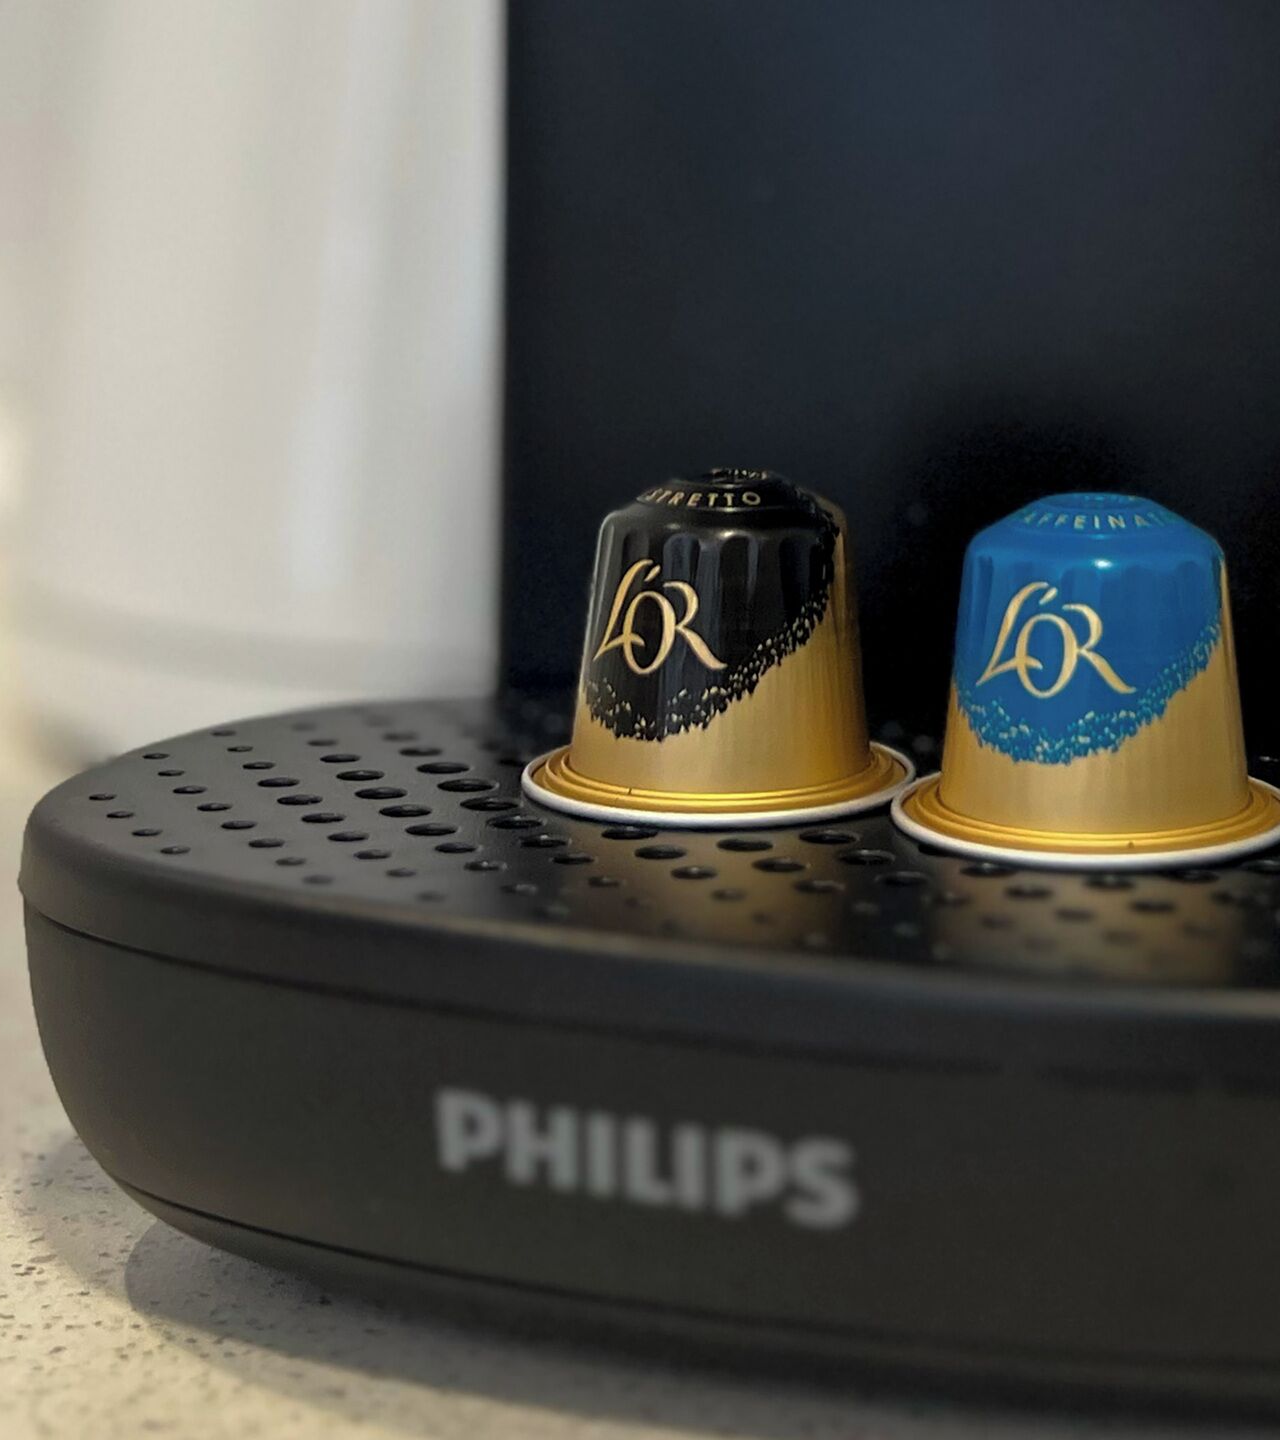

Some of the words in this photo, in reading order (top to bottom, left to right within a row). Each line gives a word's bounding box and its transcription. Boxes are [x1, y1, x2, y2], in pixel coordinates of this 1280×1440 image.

[593, 559, 728, 675] L'OR
[975, 581, 1137, 698] L'OR
[434, 1085, 860, 1230] PHILIPS
